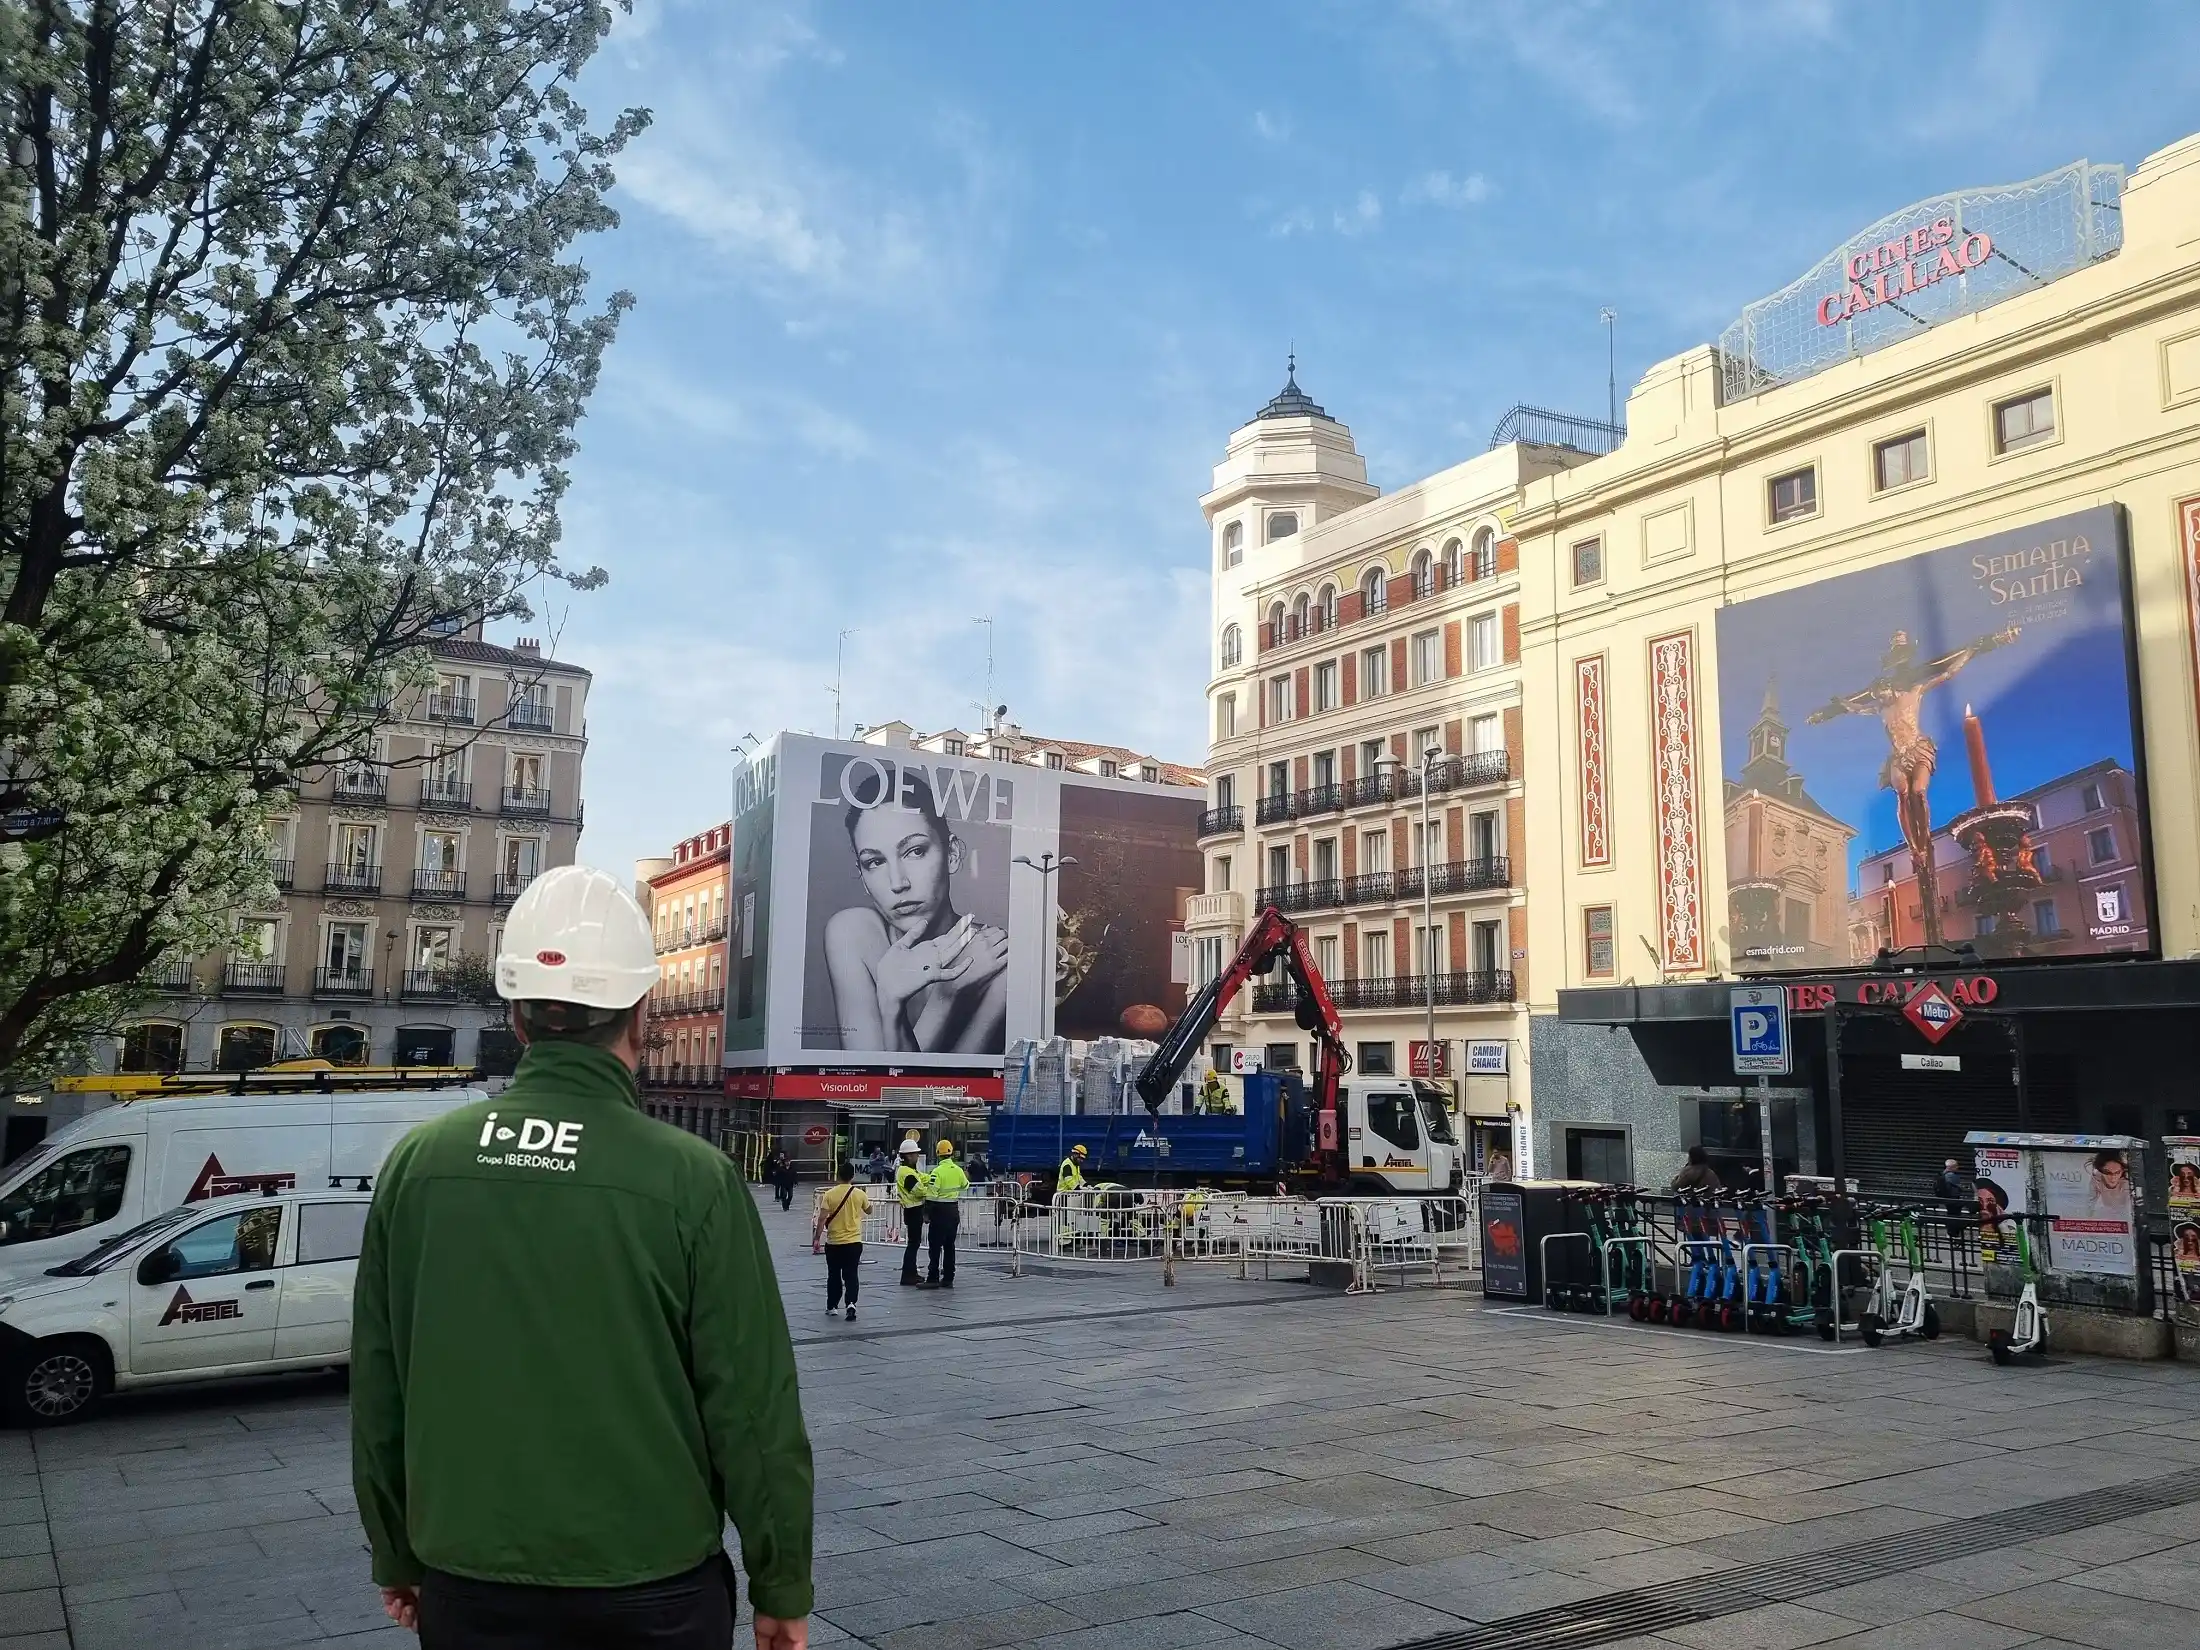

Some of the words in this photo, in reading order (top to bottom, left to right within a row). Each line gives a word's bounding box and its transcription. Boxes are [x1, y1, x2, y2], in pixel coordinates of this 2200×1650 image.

[1849, 216, 1954, 281] CINES
[1817, 232, 1992, 326] CALLAO
[1972, 535, 2091, 580] SEMANA
[2010, 561, 2083, 605] SANTA
[732, 754, 776, 821] LOEWE
[812, 752, 1014, 825] LOEWE
[2089, 925, 2130, 936] MADRID
[1745, 945, 1805, 956] esmadrid.com
[1857, 976, 1998, 1007] CALAO
[1923, 1003, 1950, 1019] Metro
[1740, 1012, 1768, 1051] P
[1472, 1045, 1502, 1057] CAMBIO
[1472, 1057, 1501, 1068] CHANGE
[1920, 1058, 1944, 1068] Callao
[820, 1083, 868, 1093] VisionLab!
[477, 1154, 503, 1165] Grupo
[504, 1153, 576, 1172] IBERDROLA
[1383, 1152, 1415, 1168] AMETEL
[1981, 1160, 2019, 1169] OUTLET
[2061, 1238, 2124, 1255] MADRID
[157, 1283, 244, 1327] AMETEL
